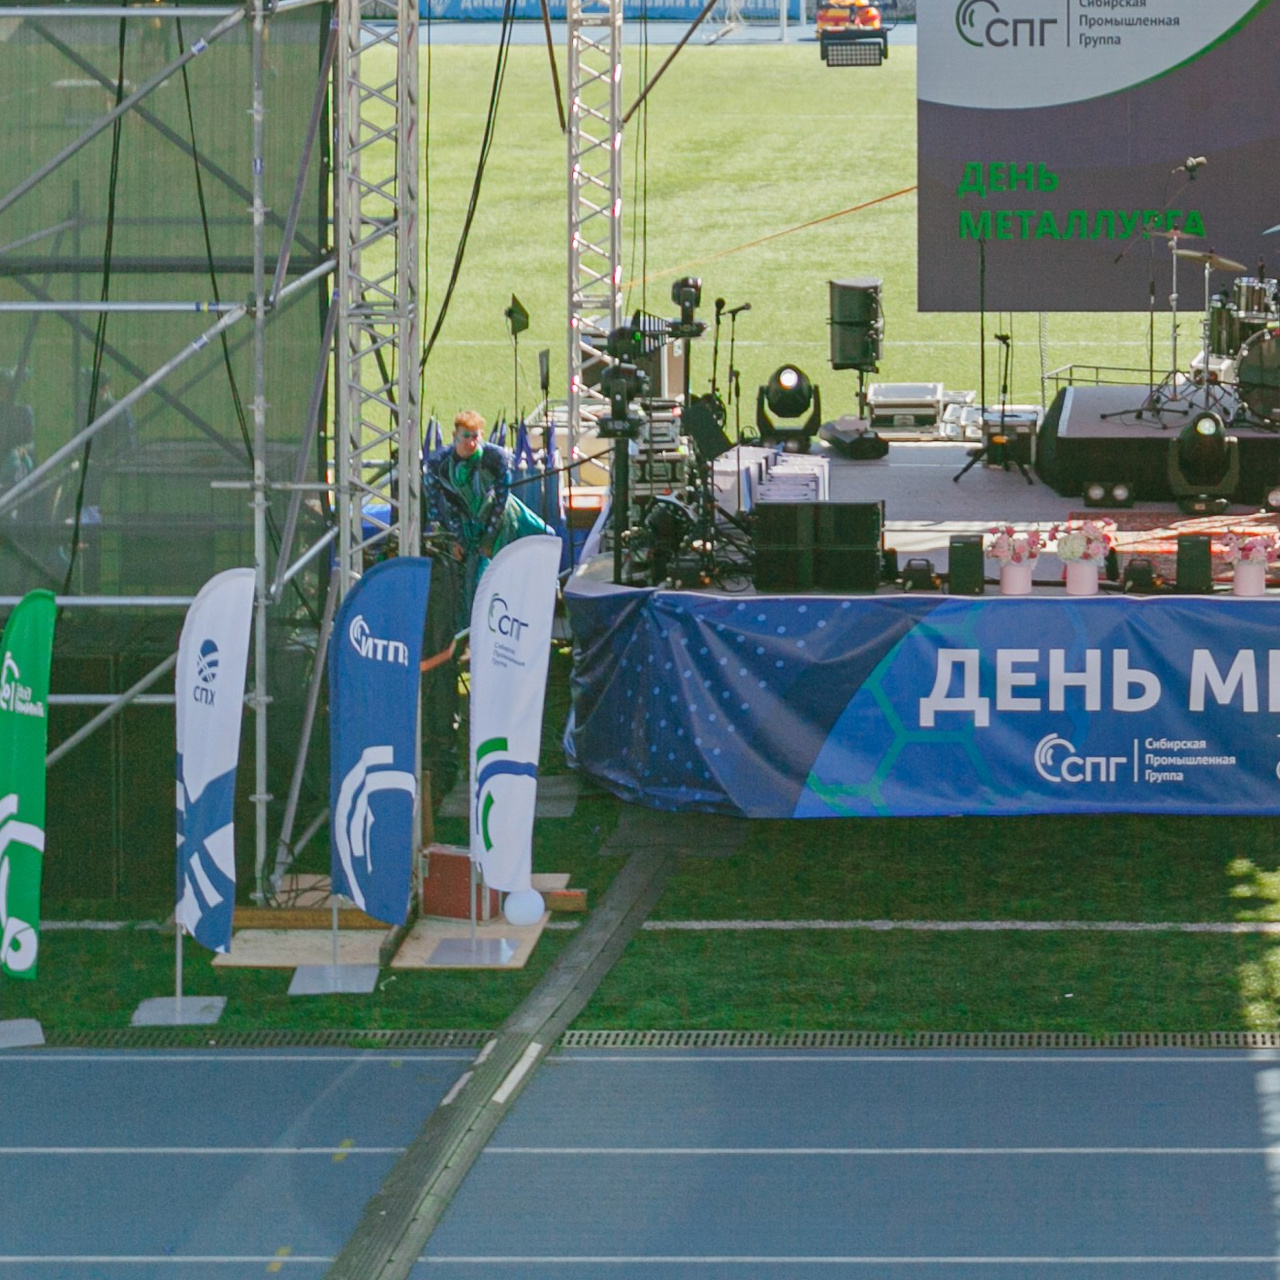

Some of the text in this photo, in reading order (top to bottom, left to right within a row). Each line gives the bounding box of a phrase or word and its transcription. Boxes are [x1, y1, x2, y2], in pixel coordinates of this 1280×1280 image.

[1079, 15, 1180, 29] Промышленная
[1079, 33, 1121, 48] Группа
[957, 161, 1059, 199] ДЕНЬ
[959, 210, 1207, 240] МЕТАЛЛУРГА
[919, 648, 1162, 728] ДЕНЬ
[193, 685, 216, 707] СПХ
[1145, 738, 1206, 751] Сибирская
[1145, 754, 1236, 767] Промышленная
[1145, 770, 1184, 783] Группа
